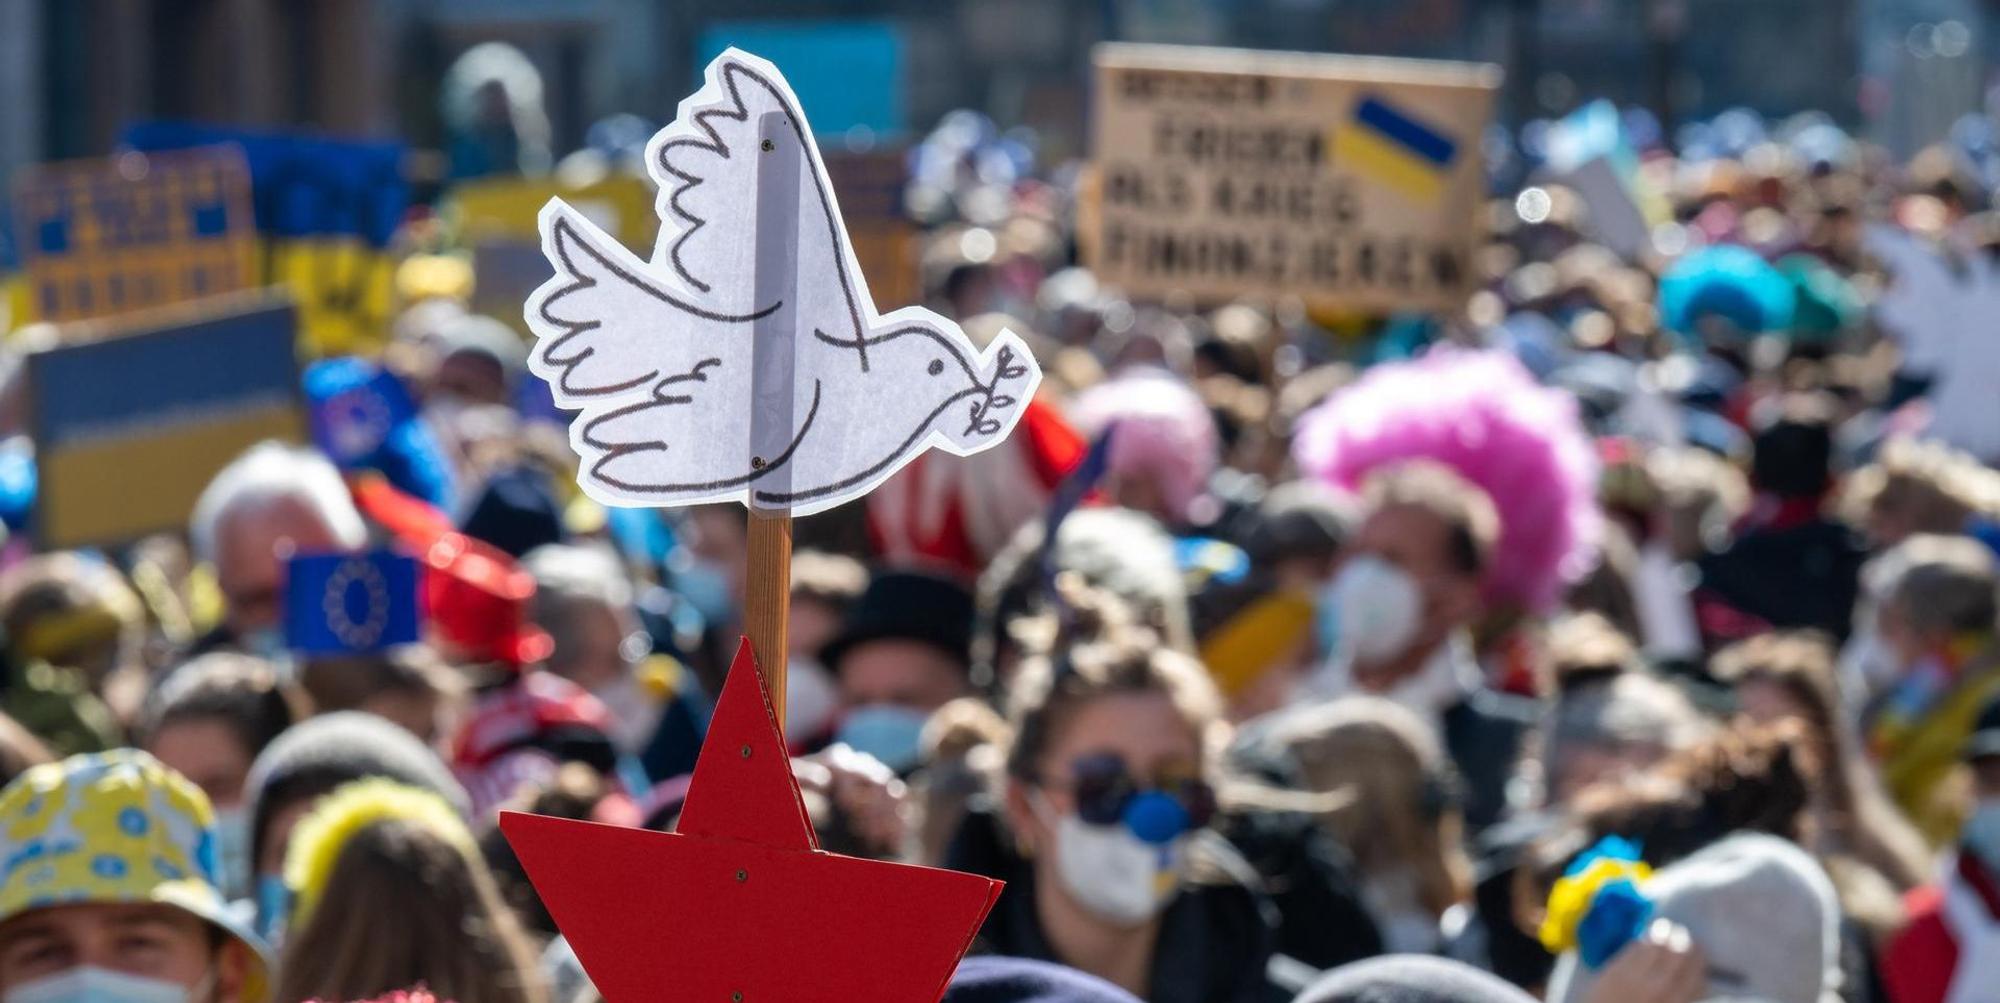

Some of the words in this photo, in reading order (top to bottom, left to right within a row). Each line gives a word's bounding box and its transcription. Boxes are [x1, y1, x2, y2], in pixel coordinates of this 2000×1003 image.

[1106, 163, 1188, 207] ALS
[1213, 175, 1361, 225] KRIEG
[1106, 223, 1464, 289] FINANZIEREN
